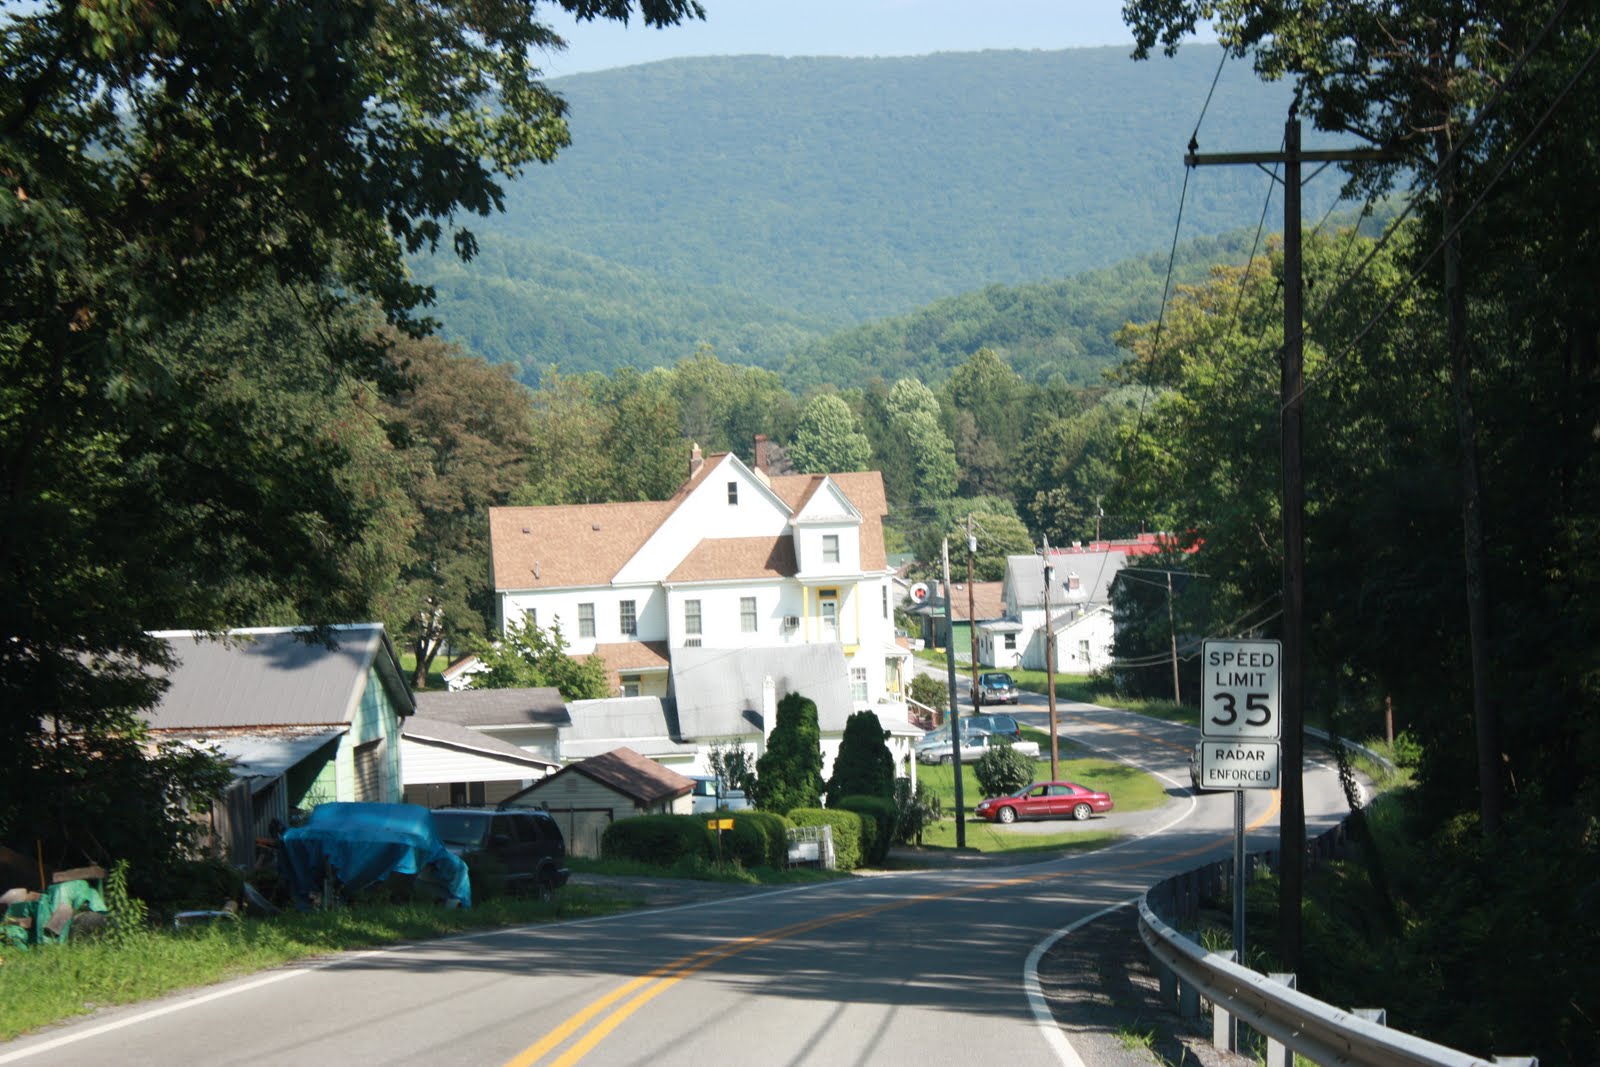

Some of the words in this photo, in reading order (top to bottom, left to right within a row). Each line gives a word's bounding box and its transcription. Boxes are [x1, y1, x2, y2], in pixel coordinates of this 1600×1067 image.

[1210, 652, 1274, 667] SPEED
[1216, 672, 1266, 687] LIMIT
[1211, 692, 1272, 726] 35
[1215, 749, 1265, 760] RADAR
[1209, 768, 1271, 781] ENFORCED
